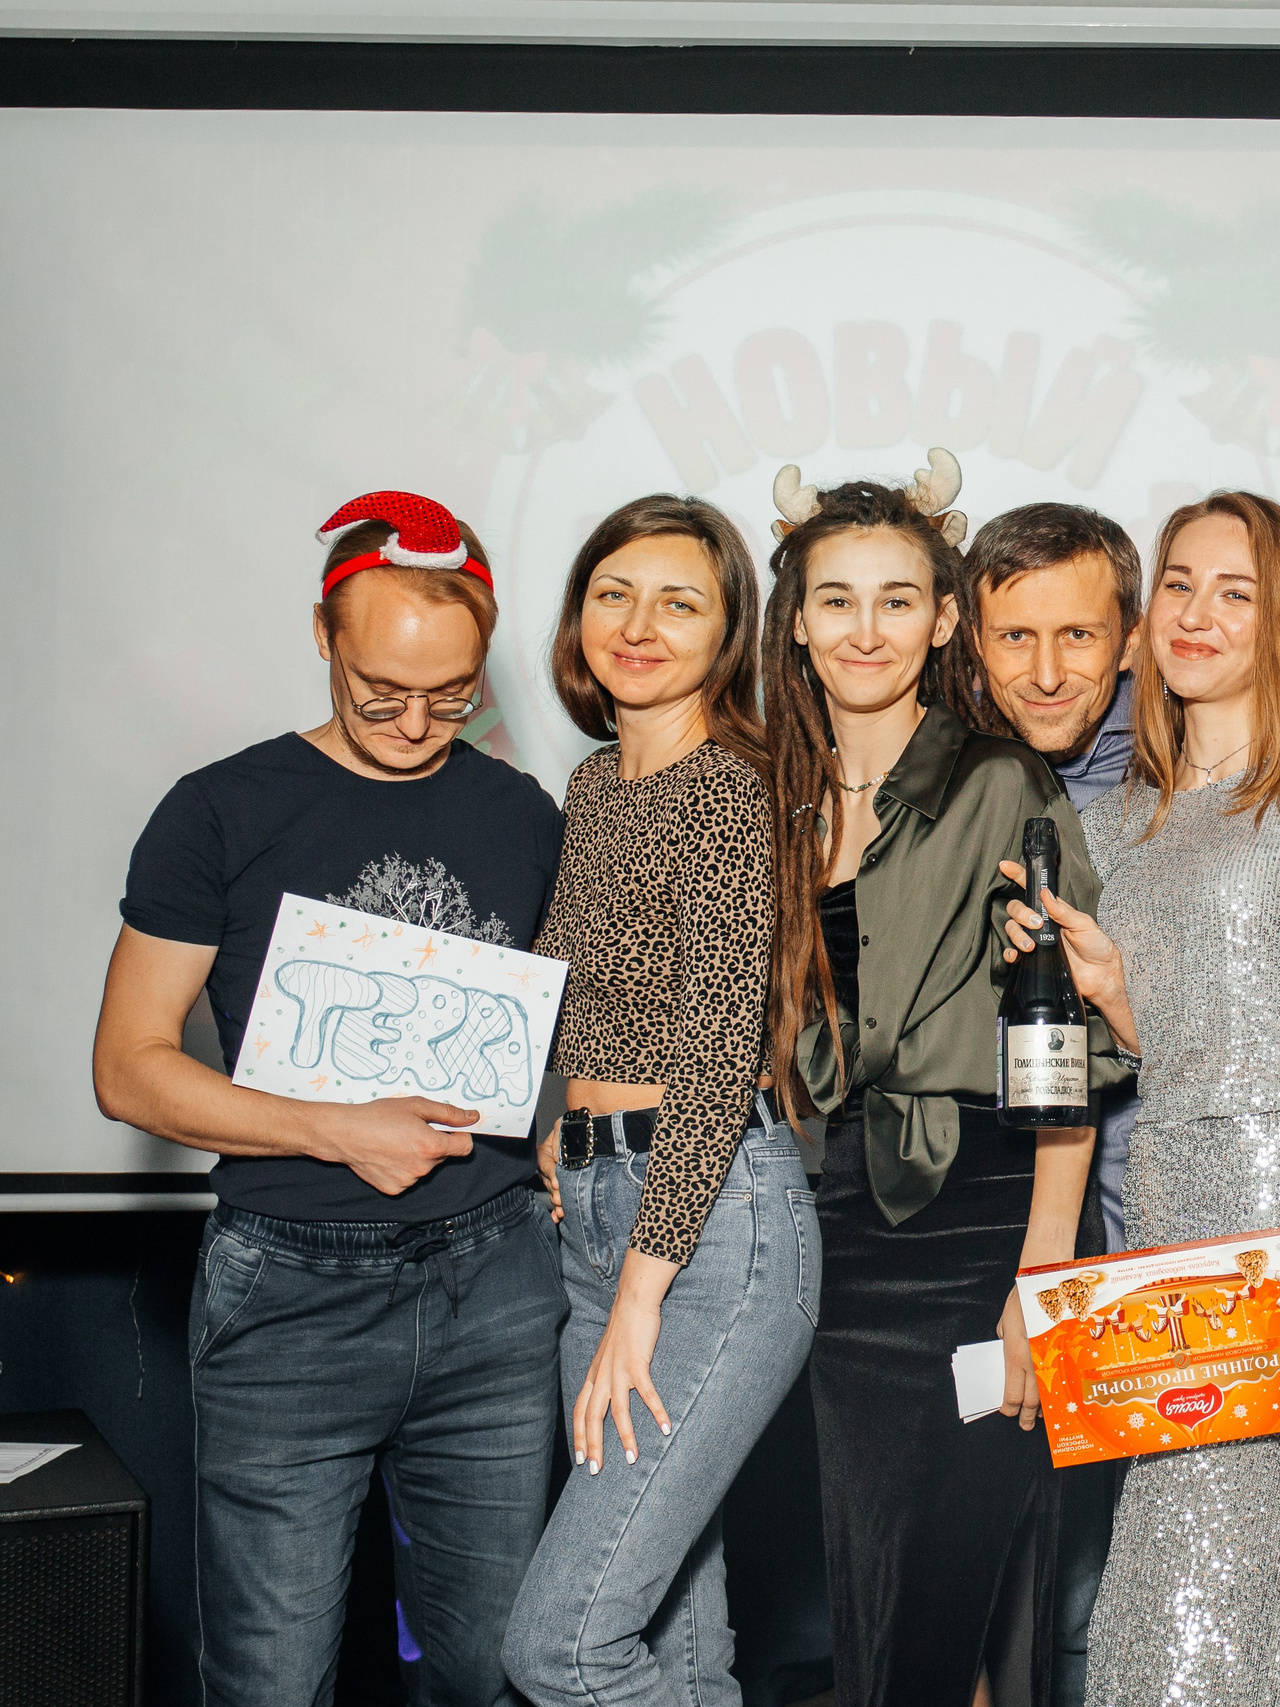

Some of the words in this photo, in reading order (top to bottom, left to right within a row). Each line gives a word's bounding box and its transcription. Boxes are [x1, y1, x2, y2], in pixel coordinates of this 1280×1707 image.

[633, 318, 1147, 490] НОВЫЙ
[1039, 933, 1055, 941] 1928
[1188, 1259, 1220, 1271] Карусель
[1192, 1350, 1225, 1362] НАЧИНКОЙ
[1225, 1345, 1263, 1357] АРАХИСОВОЙ
[1130, 1362, 1165, 1373] ВАФЕЛЬНОЙ
[1200, 1353, 1280, 1379] РОДНЫЕ
[1101, 1368, 1130, 1378] КРОШКОЙ
[1091, 1368, 1197, 1398] ПРОСТОРЫ
[1165, 1394, 1215, 1416] Россия
[1057, 1439, 1088, 1448] ГОРОСКОП
[1059, 1434, 1083, 1442] ВНУТРИ!
[1053, 1443, 1094, 1454] НОВОГОДНИЙ
